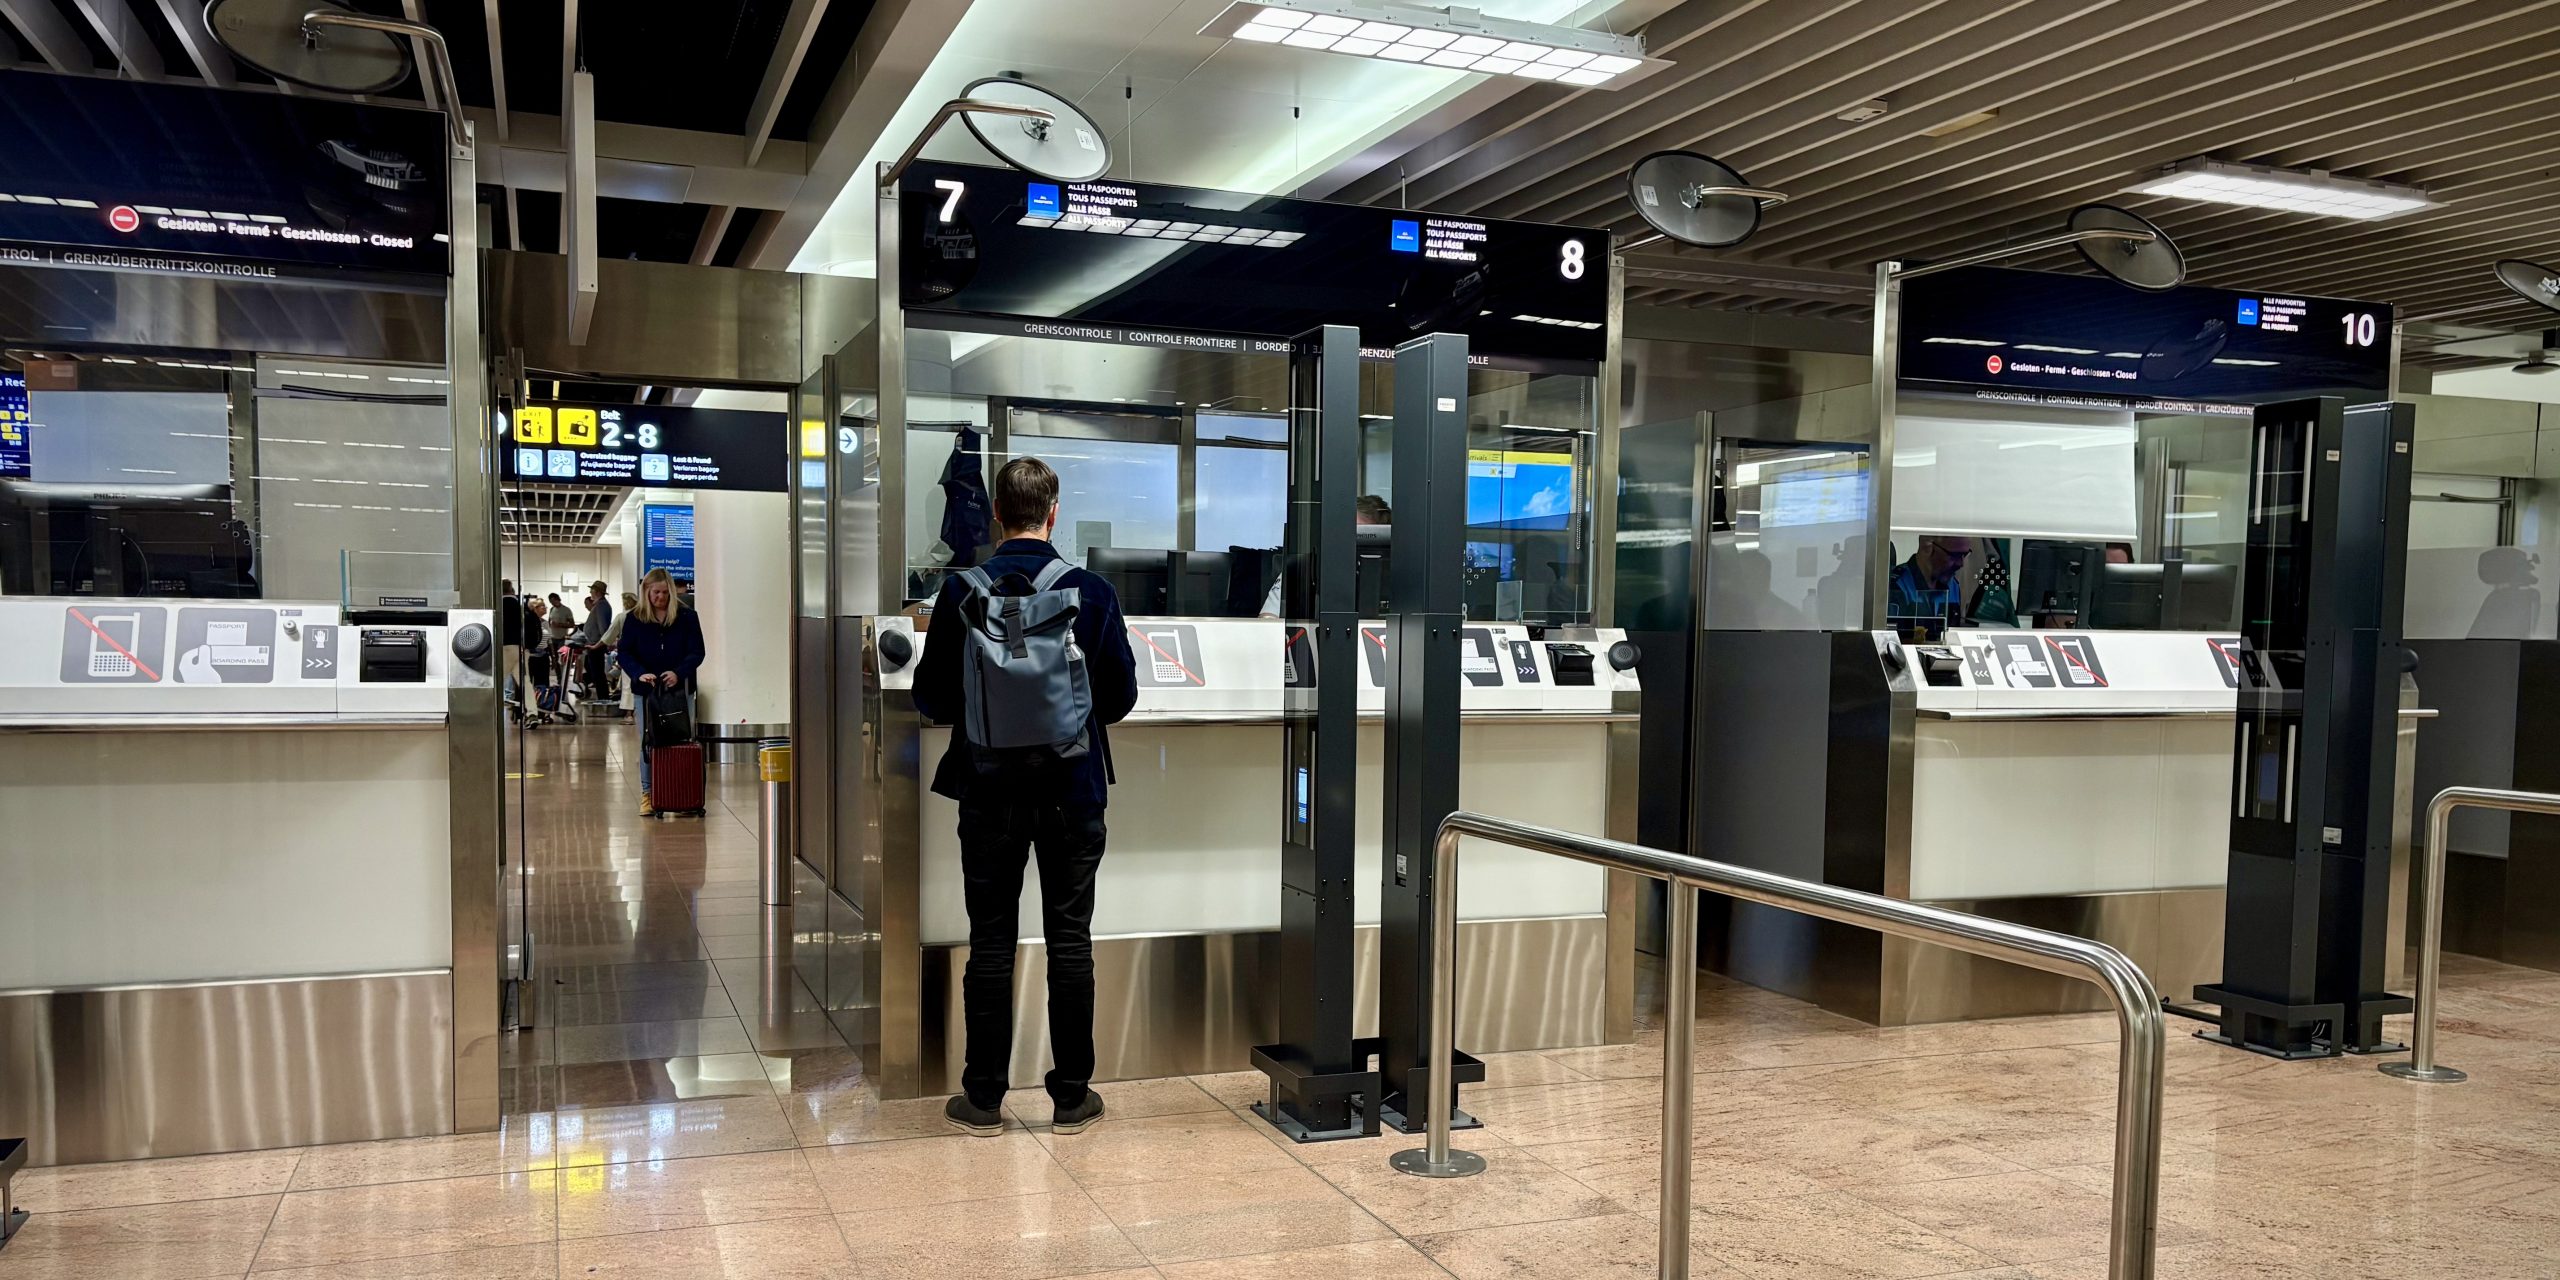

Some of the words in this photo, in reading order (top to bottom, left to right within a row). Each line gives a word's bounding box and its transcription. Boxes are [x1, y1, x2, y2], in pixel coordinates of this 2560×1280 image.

[1087, 184, 1136, 196] PASPOORTEN
[935, 179, 965, 222] 7
[1068, 193, 1088, 202] TOUS
[1090, 196, 1138, 208] PASSEPORTS
[1068, 204, 1087, 213] ALLE
[1068, 215, 1082, 224] ALL
[1083, 216, 1126, 228] PASSPORTS
[1426, 219, 1442, 227] ALLE
[1443, 220, 1486, 231] PASPOORTEN
[157, 216, 218, 232] Gesloten
[228, 222, 271, 237] Fermé
[281, 226, 361, 244] Geschlossen
[370, 234, 414, 248] Closed
[1426, 229, 1445, 238] TOUS
[1446, 230, 1487, 242] PASSEPORTS
[1425, 239, 1442, 248] ALLE
[1425, 250, 1438, 258] ALL
[1439, 250, 1477, 261] PASSPORTS
[1560, 240, 1585, 280] 8
[0, 248, 39, 261] TROL
[64, 252, 277, 278] GRENZÜBERTRITTSKONTROLLE
[2341, 312, 2376, 347] 10
[1024, 323, 1112, 340] GRENSCONTROLE
[1129, 332, 1182, 345] CONTROLE
[1184, 336, 1237, 349] FRONTIERE
[1256, 341, 1289, 352] BORDE
[1468, 356, 1488, 365] OLLE
[2010, 362, 2040, 374] Gesloten
[2045, 364, 2066, 375] Fermé
[2071, 366, 2111, 378] Geschlossen
[2115, 370, 2137, 380] Closed
[1976, 390, 2036, 402] GRENSCONTROLE
[2047, 395, 2084, 405] CONTROLE
[2085, 398, 2122, 408] FRONTIERE
[2136, 400, 2163, 410] BORDER
[2164, 402, 2195, 412] CONTROL
[600, 410, 620, 420] Belt
[601, 422, 658, 448] 2-8
[580, 452, 612, 460] Oversized
[581, 461, 613, 470] Afwijkende
[614, 462, 636, 470] bagage
[698, 465, 720, 473] bagage
[581, 469, 606, 477] Bagages
